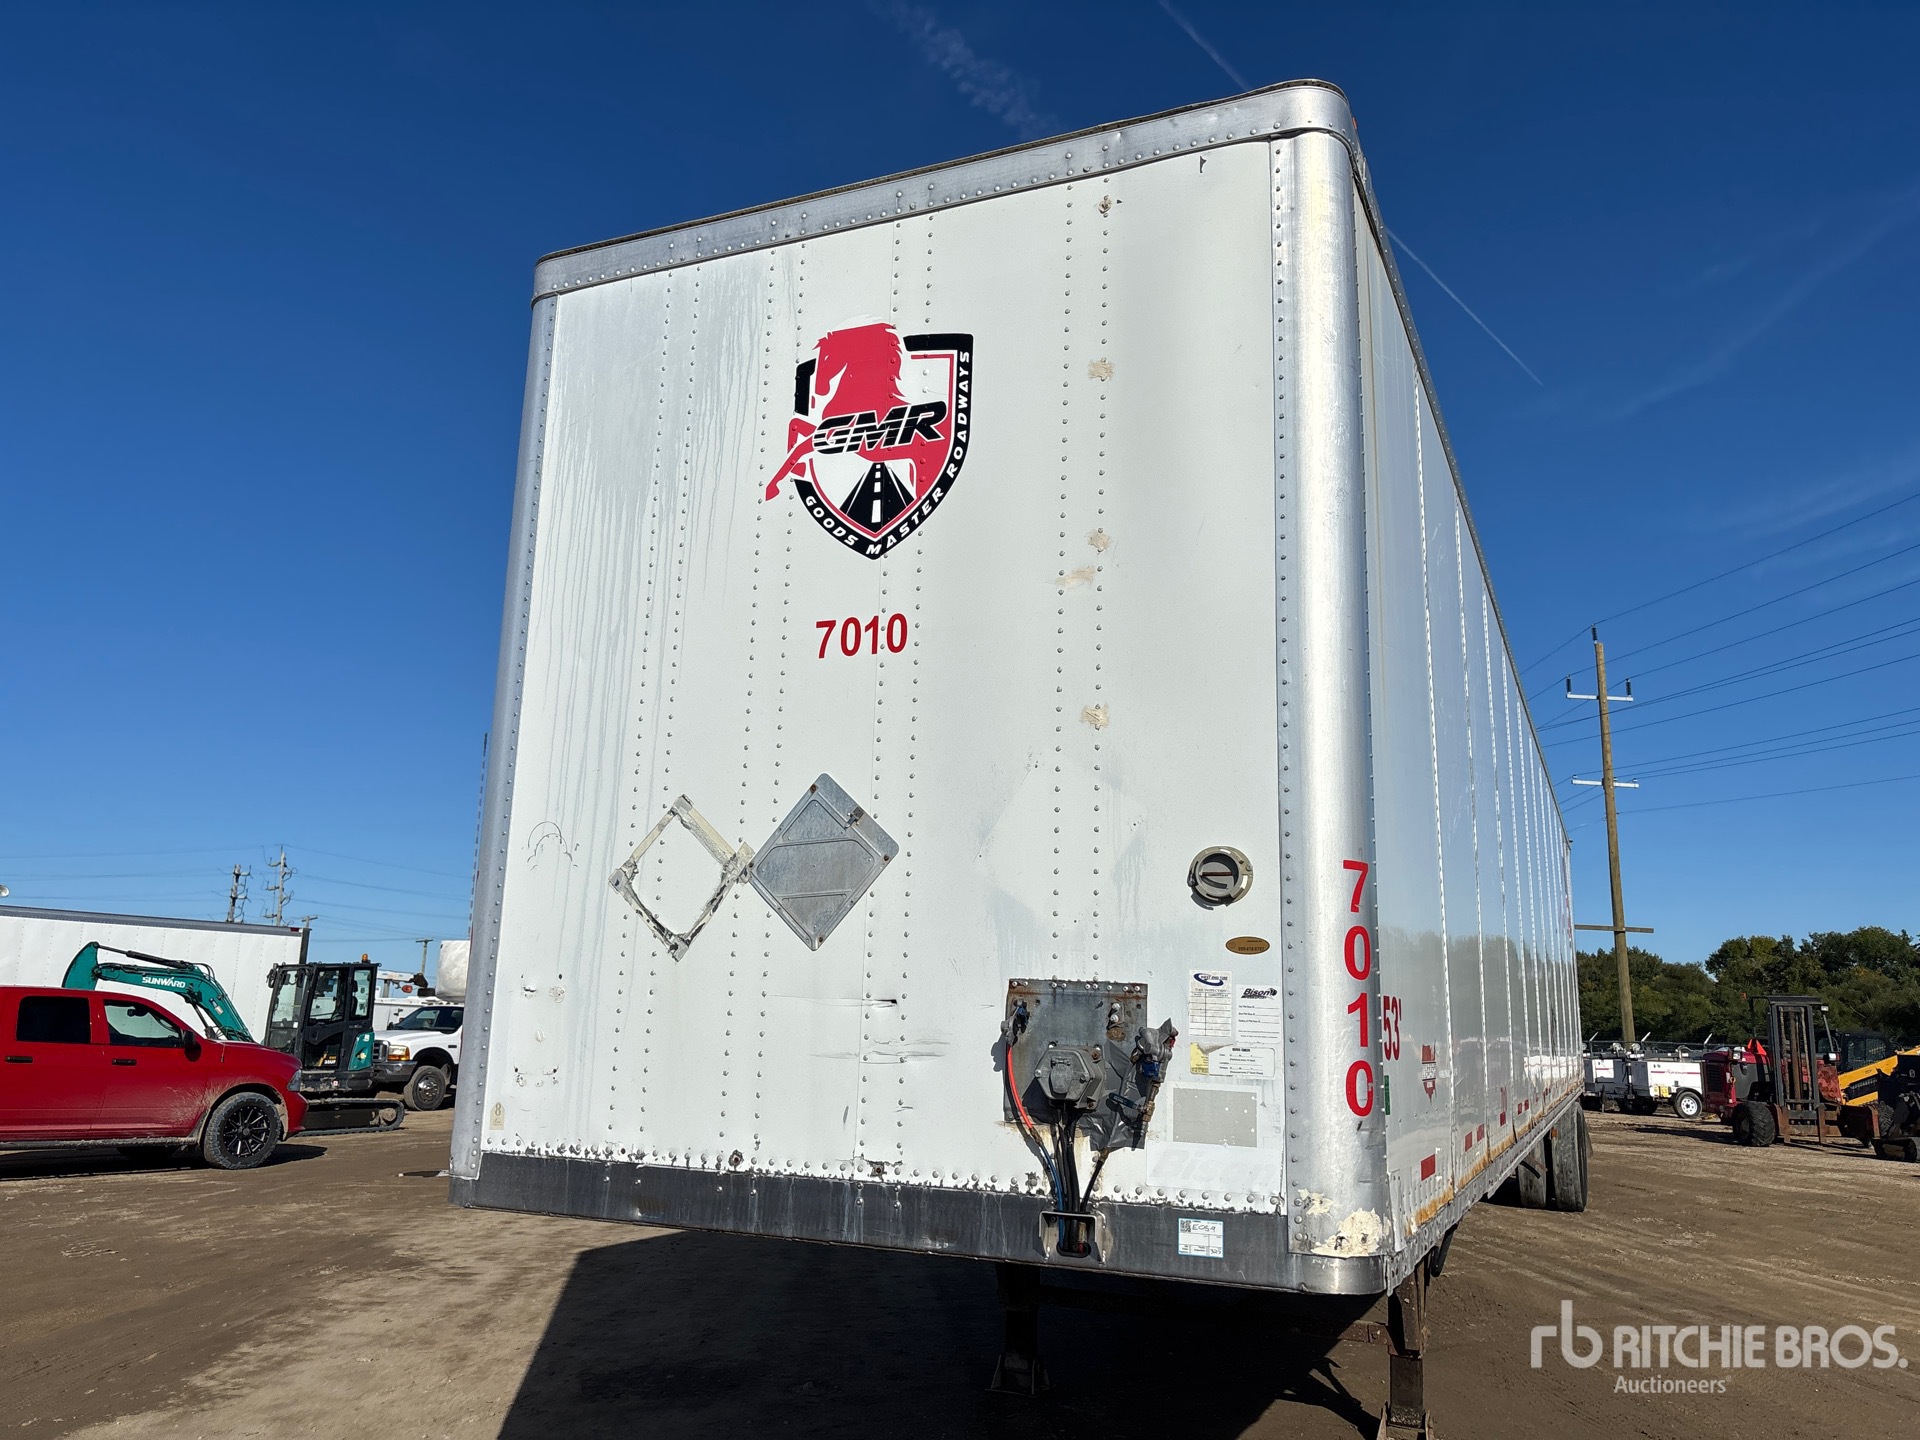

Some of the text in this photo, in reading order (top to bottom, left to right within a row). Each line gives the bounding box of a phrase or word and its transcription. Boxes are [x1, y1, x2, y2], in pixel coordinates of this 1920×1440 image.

[812, 401, 947, 454] GMR
[805, 351, 970, 555] GOODS MASTER ROADWAYS
[816, 613, 908, 659] 7010
[142, 976, 186, 989] SUNWARD
[1243, 988, 1270, 996] Bison
[1342, 859, 1374, 1117] 7010
